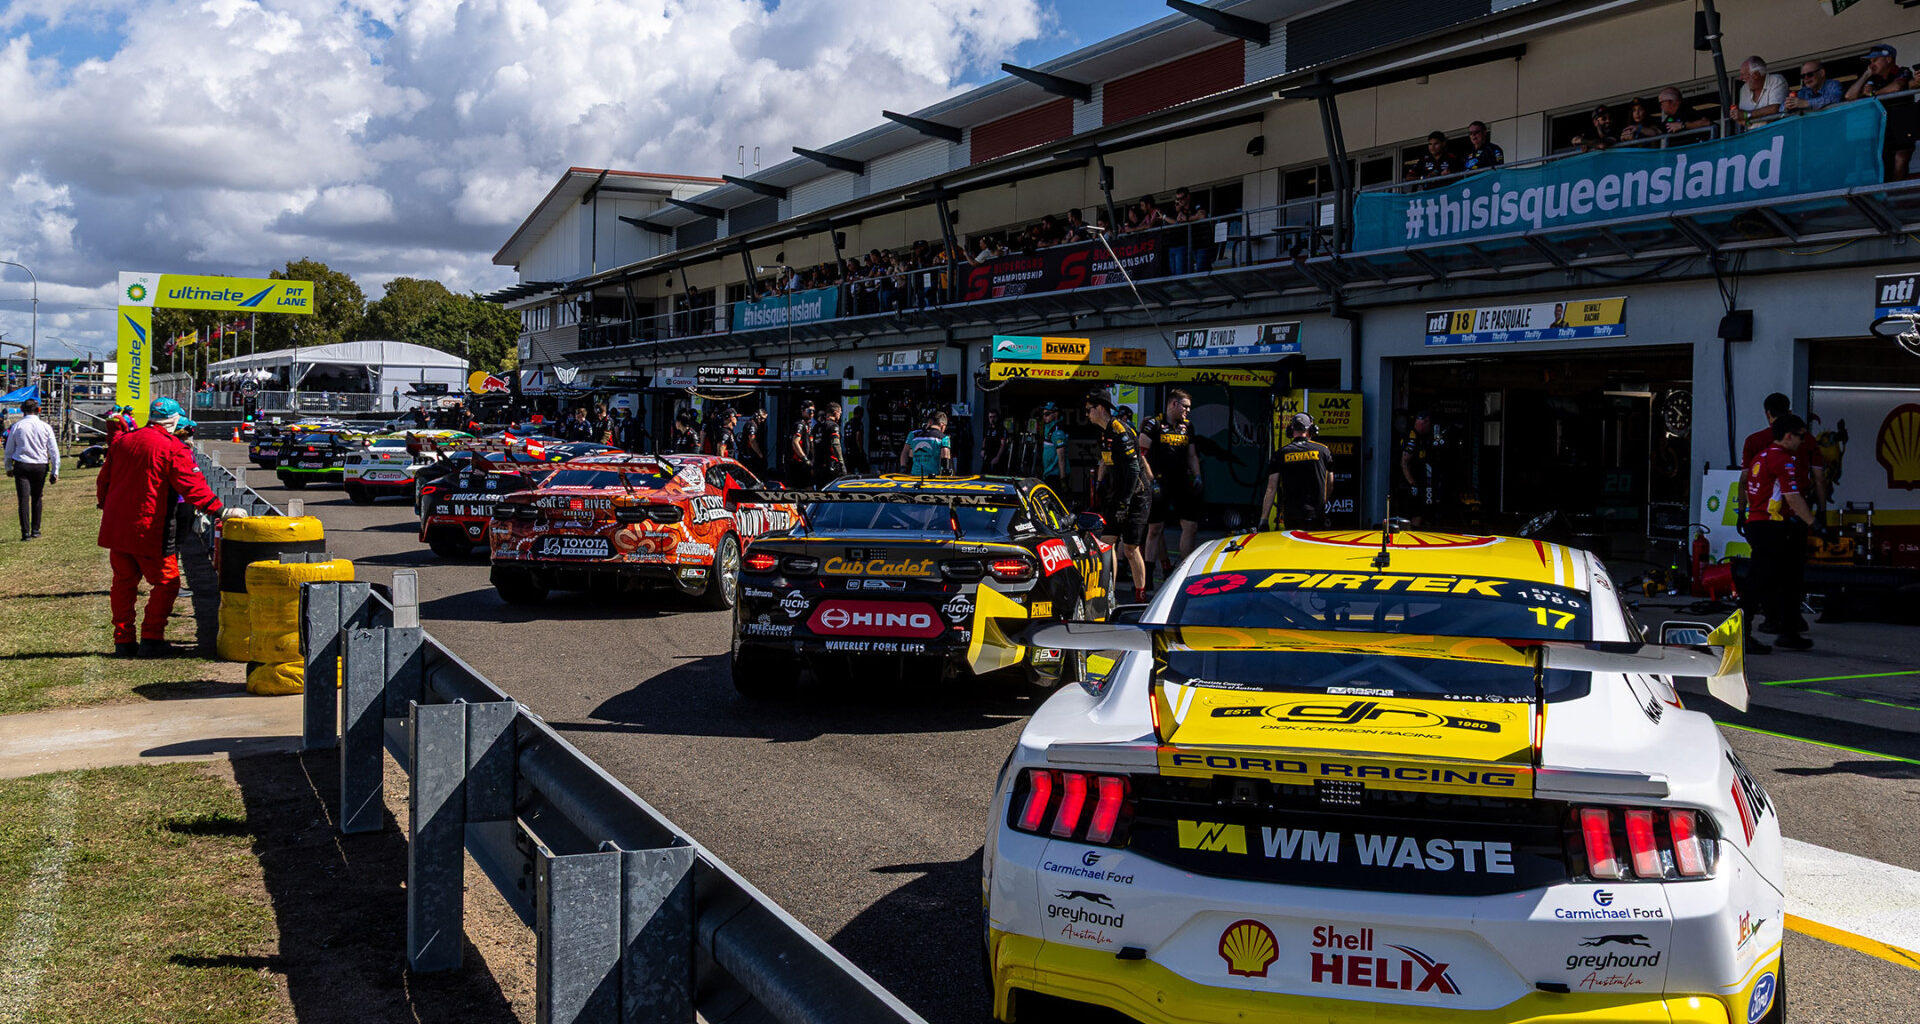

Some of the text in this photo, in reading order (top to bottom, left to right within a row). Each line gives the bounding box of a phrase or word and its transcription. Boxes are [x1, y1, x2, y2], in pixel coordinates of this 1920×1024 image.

[1406, 135, 1784, 239] #thisisqueensland
[993, 269, 1044, 284] CHAMPIONSHIP
[169, 286, 244, 302] ultimate
[285, 287, 304, 297] PIT
[1880, 277, 1915, 301] nti
[276, 297, 307, 307] LANE
[1429, 308, 1532, 333] nti 18 DE PASQUALE
[1193, 332, 1204, 347] 20
[128, 340, 142, 400] ultimate
[698, 367, 725, 375] OPTUS
[998, 366, 1030, 377] JAX
[1072, 370, 1100, 378] AUTO
[1191, 372, 1220, 383] JAX
[1260, 375, 1276, 383] AUT
[1319, 398, 1351, 409] JAX
[1322, 410, 1351, 418] TYRES
[451, 493, 478, 501] TRUCK
[584, 499, 612, 509] RIVER
[755, 491, 990, 505] WORLD GYM
[1332, 499, 1353, 508] AIR
[455, 505, 484, 515] Mobil
[562, 538, 609, 548] TOYOTA
[961, 546, 988, 554] SEIKO
[824, 556, 935, 577] Cub Cadet
[1254, 572, 1509, 597] PIRTEK
[780, 599, 810, 609] FUCHS
[1518, 591, 1580, 608] 1980
[852, 612, 931, 628] HINO
[1528, 606, 1576, 630] 17
[825, 640, 926, 653] WAVERLEY FORK LIFTS
[1443, 694, 1483, 703] camp
[1222, 707, 1252, 717] EST.
[1260, 724, 1442, 740] DICK JOHNSON RACING
[1457, 719, 1489, 730] 1980
[1172, 754, 1516, 787] FORD RACING
[1261, 825, 1341, 863] WM
[1354, 833, 1516, 874] WASTE
[1043, 861, 1134, 885] Carmichael Ford
[1047, 904, 1125, 929] greyhound
[1555, 907, 1664, 919] Carmichael Ford
[1061, 923, 1113, 944] Australia
[1737, 910, 1751, 946] Jet
[1311, 925, 1374, 951] Shell
[1566, 951, 1661, 971] greyhound
[1309, 951, 1460, 996] HELIX
[1579, 971, 1644, 990] Australia
